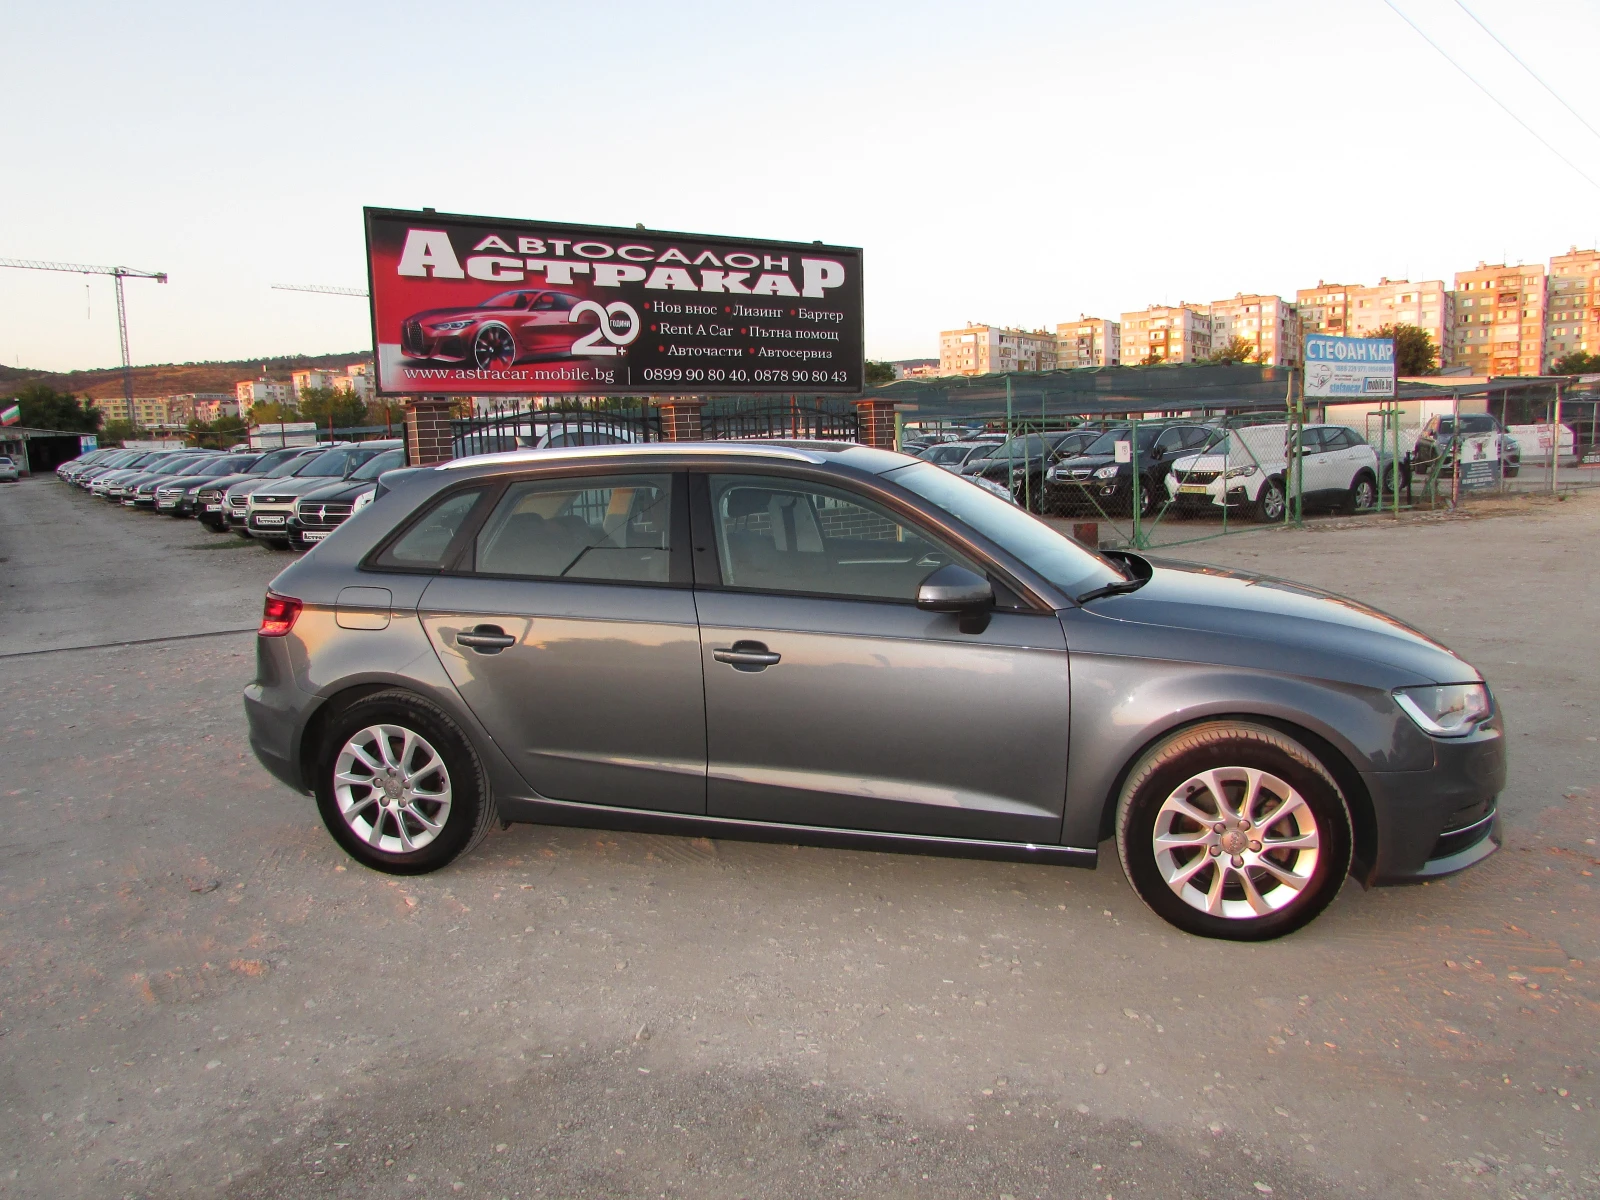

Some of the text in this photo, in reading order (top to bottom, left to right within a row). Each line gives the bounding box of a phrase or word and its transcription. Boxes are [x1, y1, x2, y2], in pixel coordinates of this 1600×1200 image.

[472, 235, 789, 271] АВТОСАЛОН
[397, 229, 845, 298] АСТРАКАР
[653, 301, 718, 315] Нов внос
[733, 305, 784, 318] Лизинг
[798, 308, 844, 323] Бартер
[659, 323, 734, 337] Rent A Car
[749, 326, 839, 342] Пътна помощ
[667, 345, 743, 357] Авточасти
[757, 347, 833, 361] Автосервиз
[1306, 339, 1394, 360] СТЕФАН КАР
[403, 366, 615, 384] www.astracar.mobile.bg
[643, 368, 847, 383] 0899 90 80 40, 0878 90 80 43
